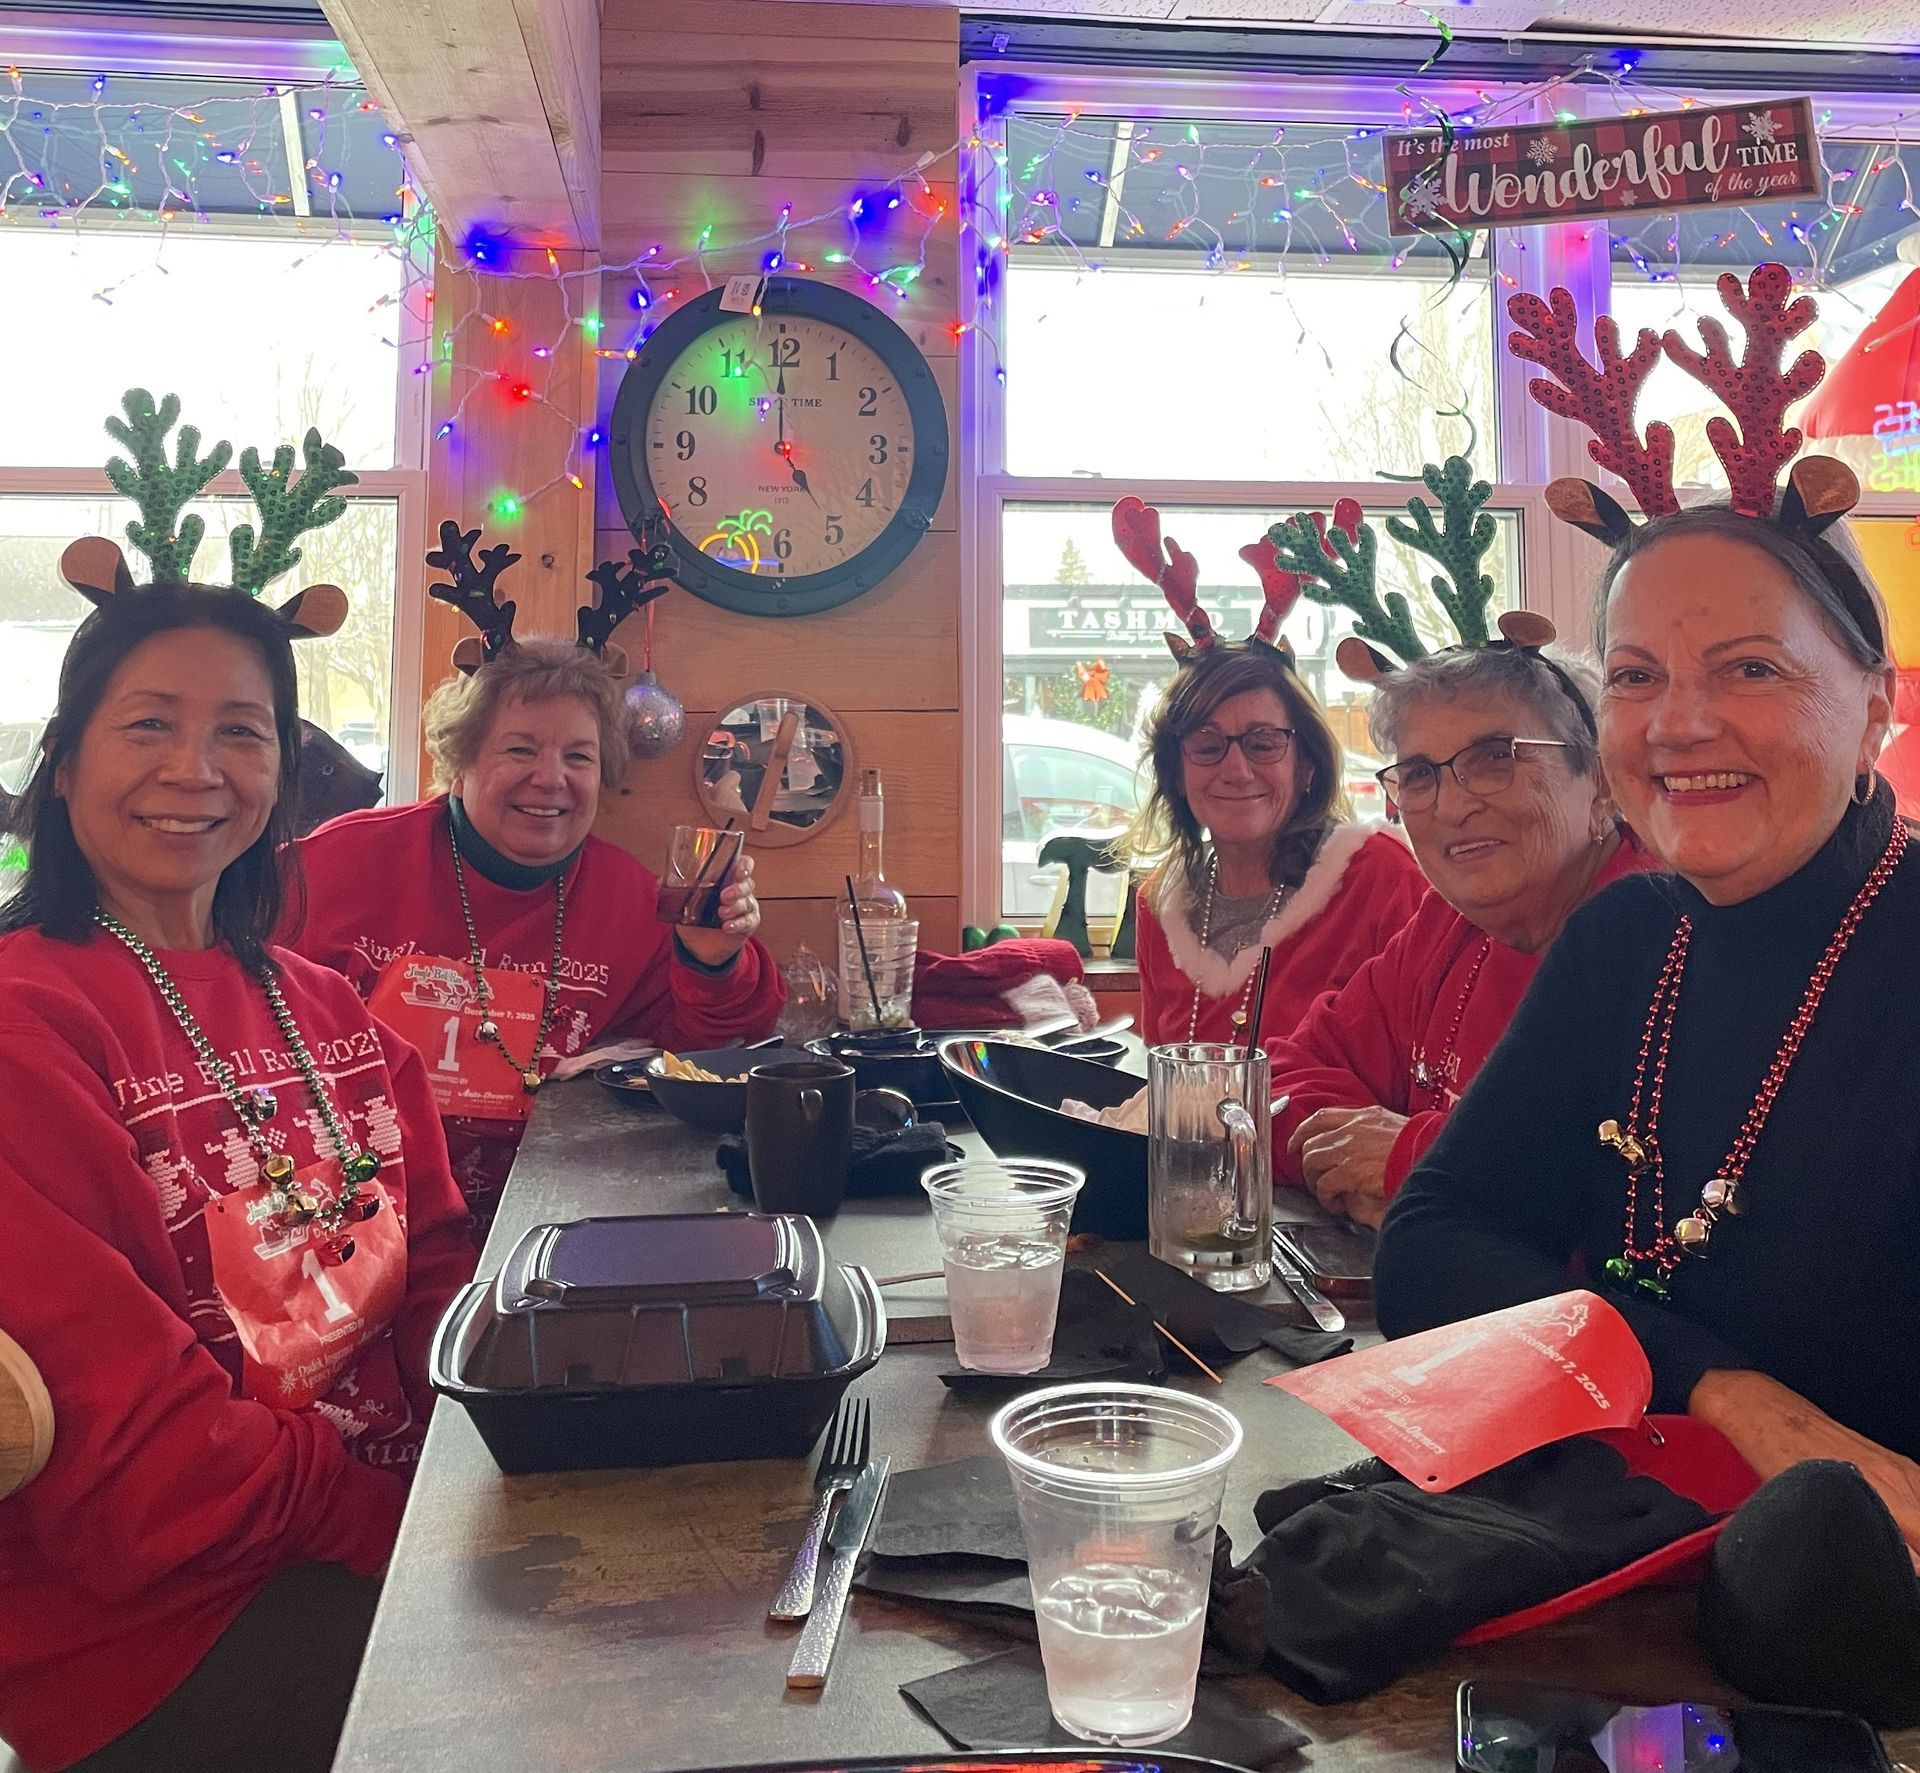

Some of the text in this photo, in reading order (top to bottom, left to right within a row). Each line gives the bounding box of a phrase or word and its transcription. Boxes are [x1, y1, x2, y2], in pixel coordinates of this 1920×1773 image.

[1397, 139, 1425, 156] It's
[1464, 132, 1510, 151] most
[1736, 142, 1798, 167] TIME
[1444, 115, 1730, 216] Wonderful
[1705, 171, 1798, 202] of the year
[721, 349, 749, 378] 11
[767, 338, 800, 367] 12
[826, 352, 840, 381] 1
[685, 385, 718, 415] 10
[792, 398, 822, 408] TIME
[858, 387, 877, 417] 2
[676, 430, 696, 461] 9
[869, 434, 888, 465] 3
[687, 476, 708, 507] 8
[758, 485, 781, 493] NEW
[856, 478, 875, 508] 4
[773, 528, 792, 560] 6
[824, 515, 844, 545] 5
[1057, 609, 1224, 631] TASHMO
[557, 956, 611, 985] 2025
[515, 1011, 536, 1021] 2025
[437, 1016, 460, 1073] 1
[302, 1248, 354, 1324] 1
[1391, 1331, 1490, 1387] 1
[1574, 1372, 1611, 1410] 2025
